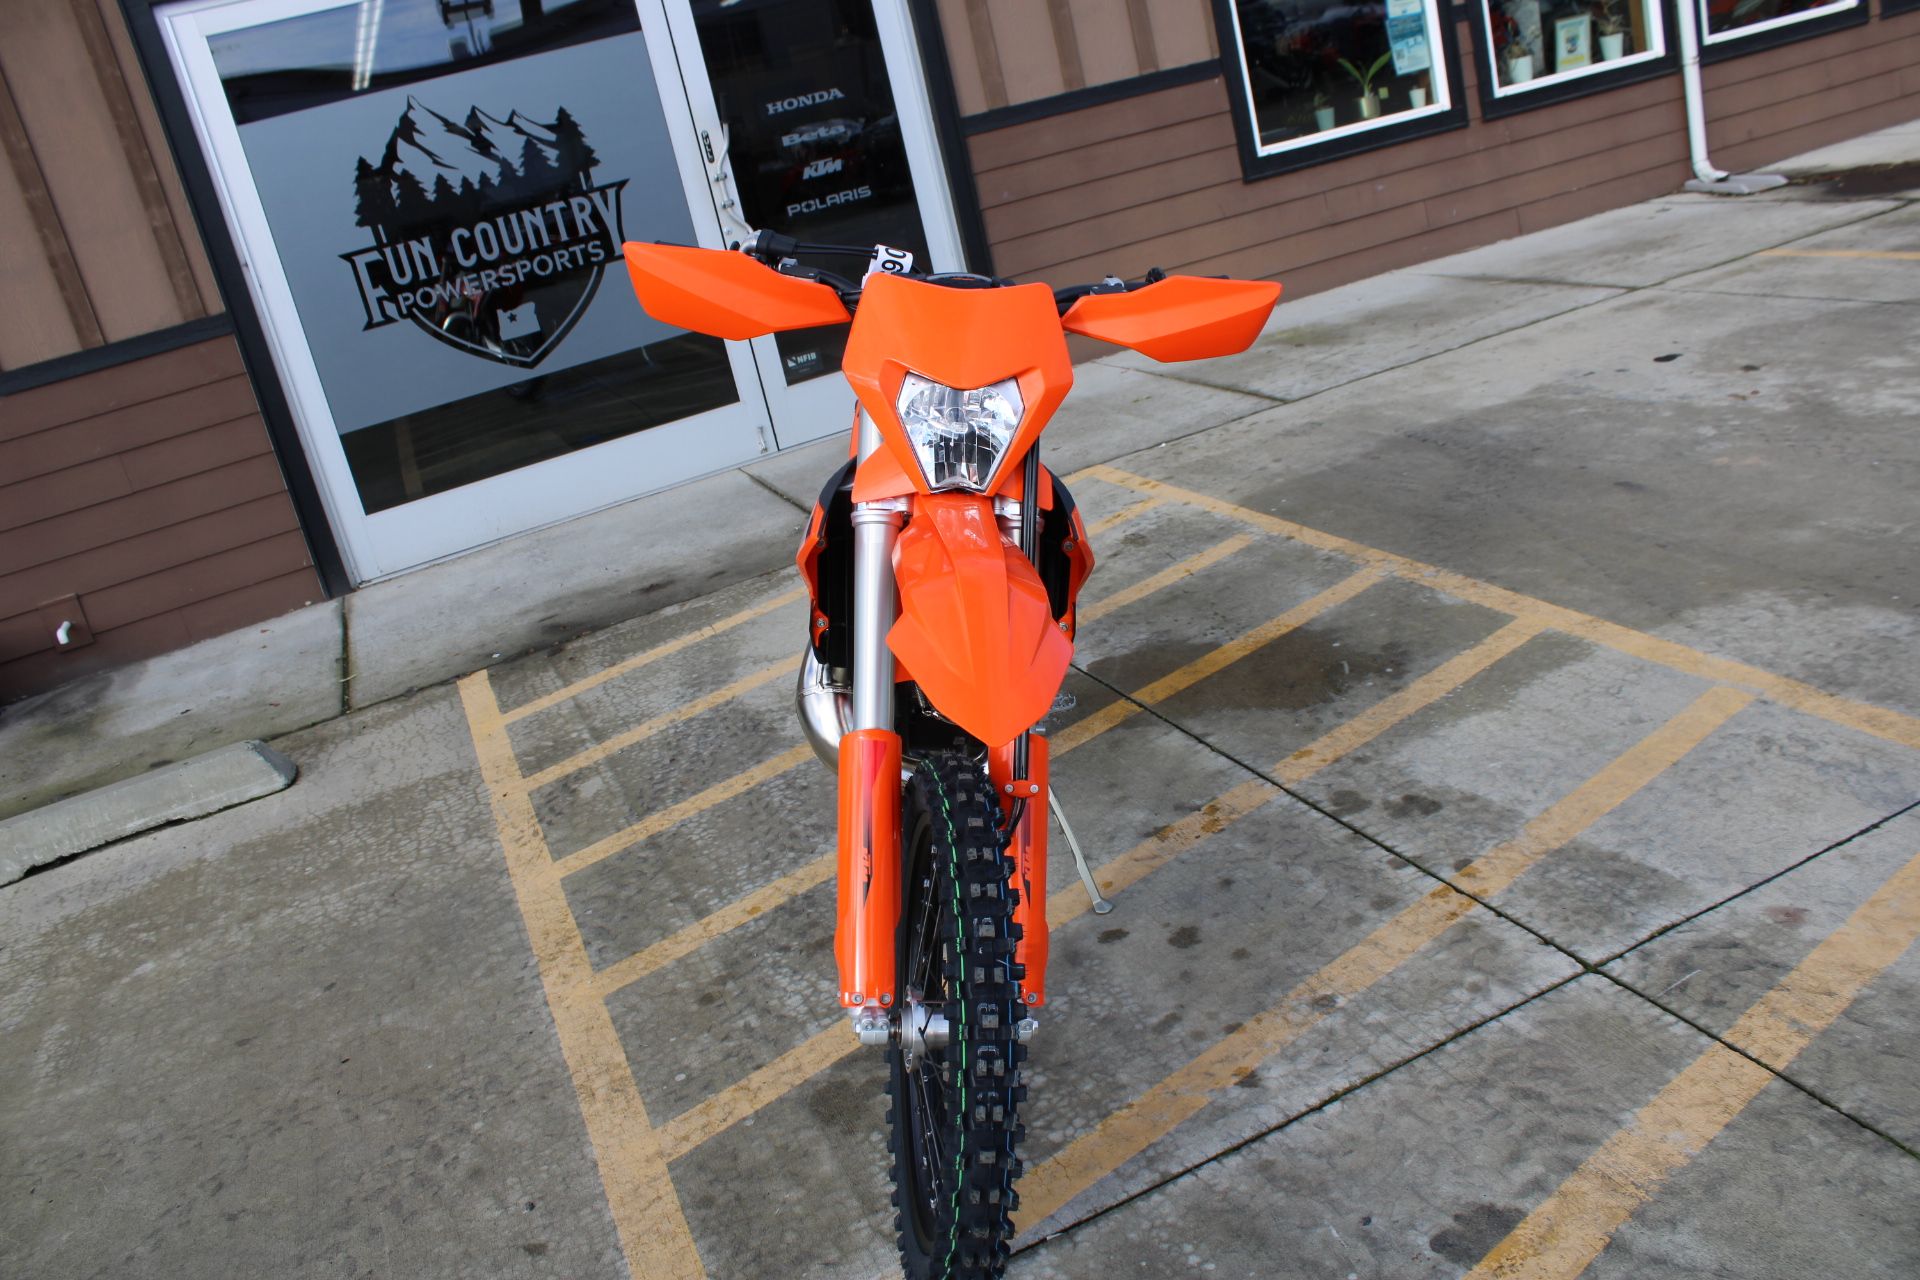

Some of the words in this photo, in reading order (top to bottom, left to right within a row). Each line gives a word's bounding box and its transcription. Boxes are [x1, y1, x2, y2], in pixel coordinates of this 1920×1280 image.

[766, 88, 845, 115] HONDA
[782, 125, 846, 147] Beta
[803, 157, 843, 180] KTM
[787, 185, 872, 217] POLARIS
[351, 236, 440, 325] FUN
[451, 186, 623, 269] COUNTRY
[398, 240, 606, 315] POWERSPORTS
